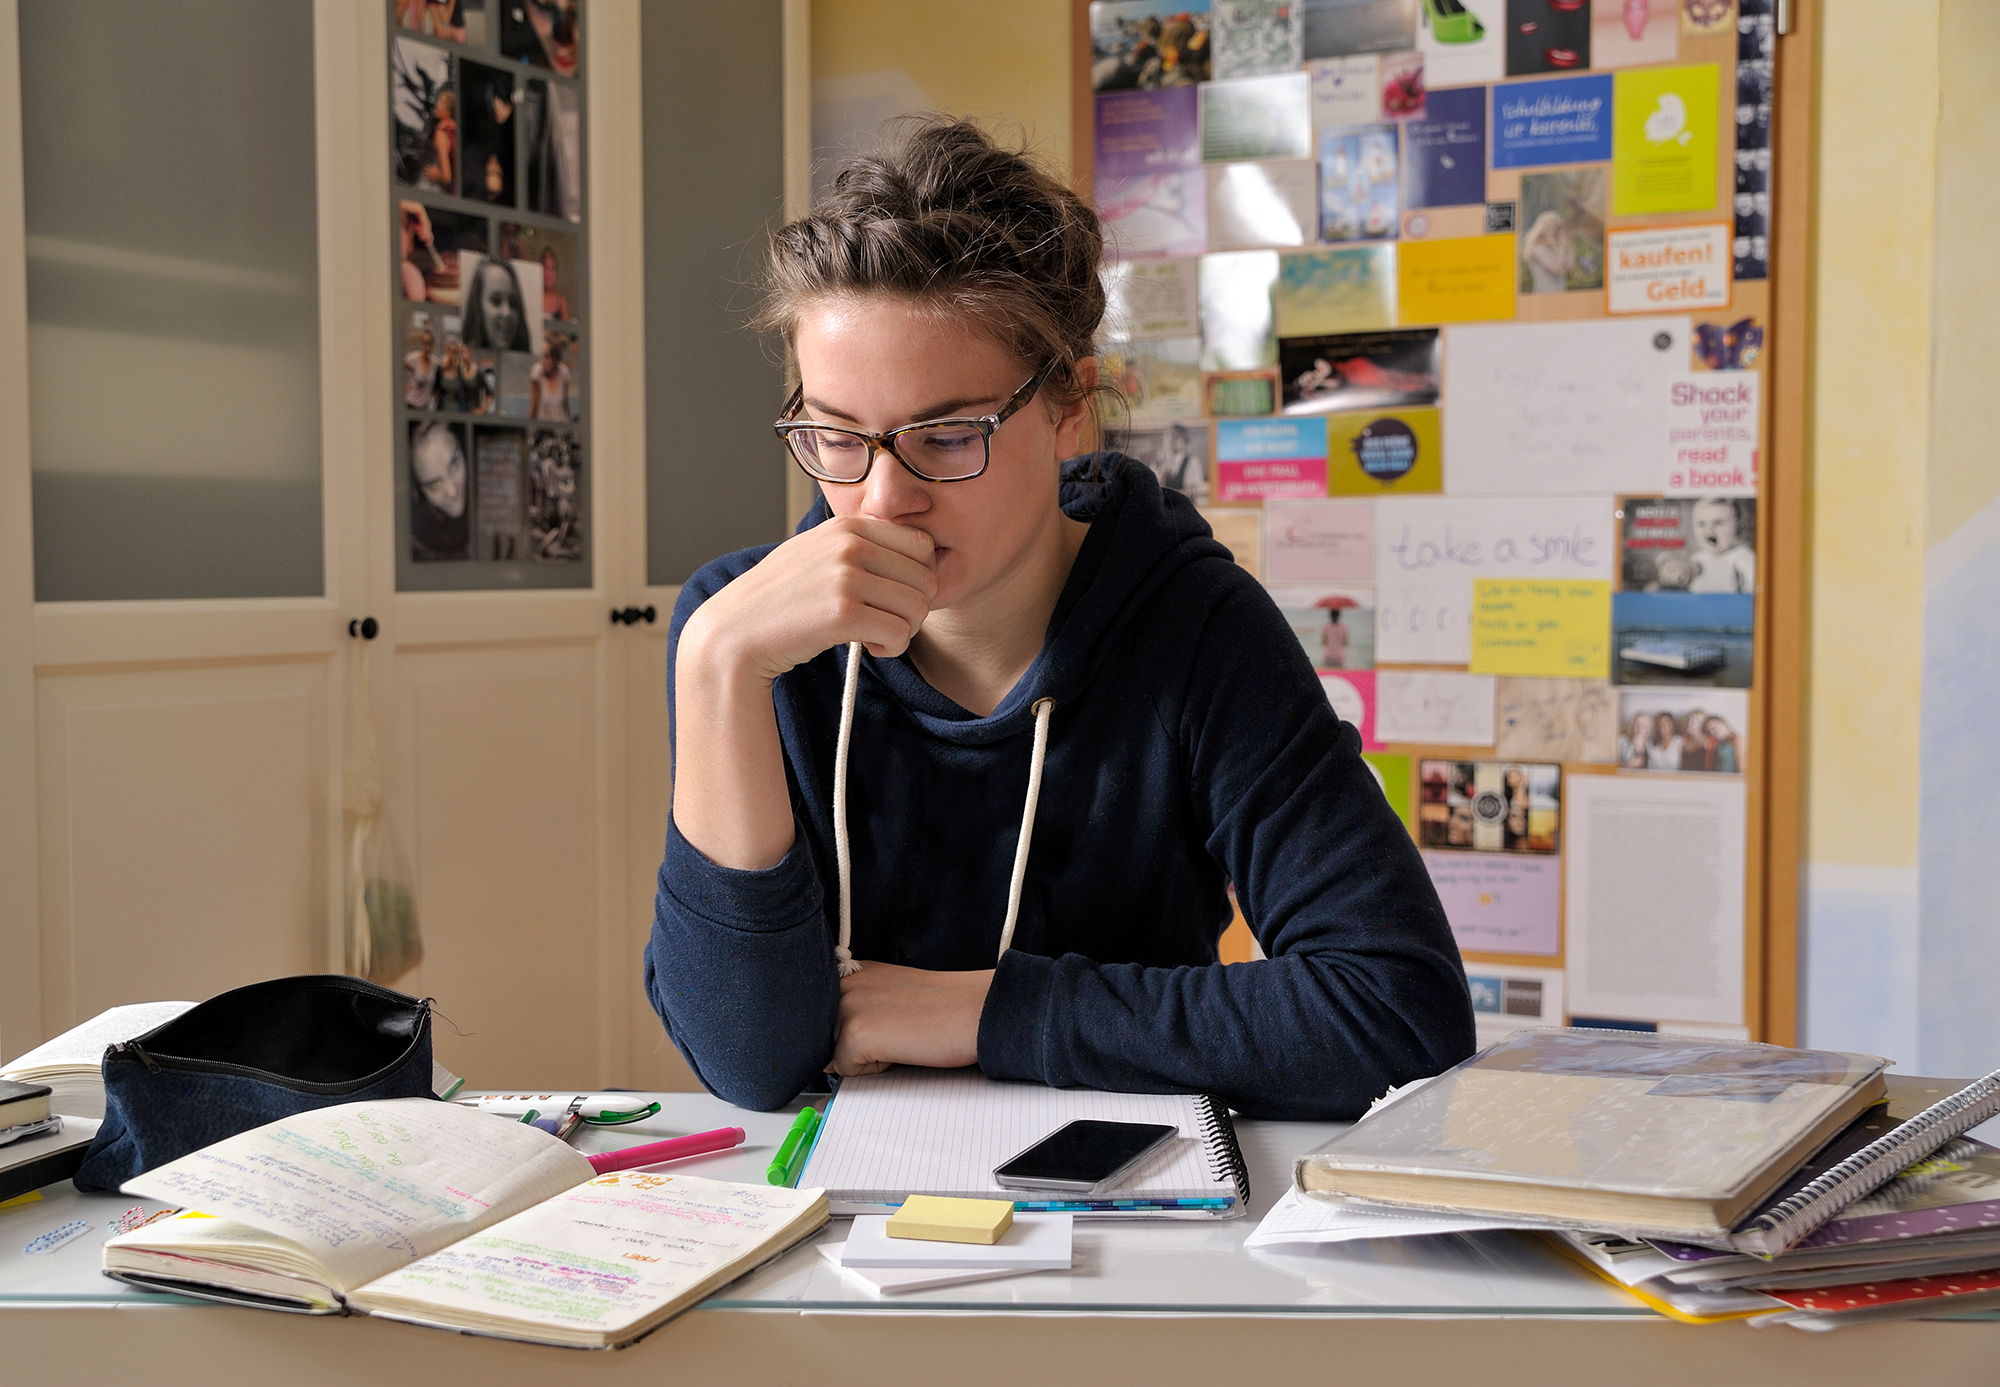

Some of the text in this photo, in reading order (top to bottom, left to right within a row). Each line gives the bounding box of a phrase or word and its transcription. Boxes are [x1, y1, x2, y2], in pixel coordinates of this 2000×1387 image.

[1618, 242, 1713, 270] kaufen!
[1646, 276, 1706, 302] Geld
[1670, 380, 1752, 407] Shock
[1699, 407, 1748, 424] your
[1669, 424, 1752, 446] parents,
[1677, 446, 1729, 465] read
[1669, 470, 1683, 489] a
[1388, 521, 1484, 571] take
[1492, 538, 1521, 565] a
[1528, 523, 1600, 567] smile
